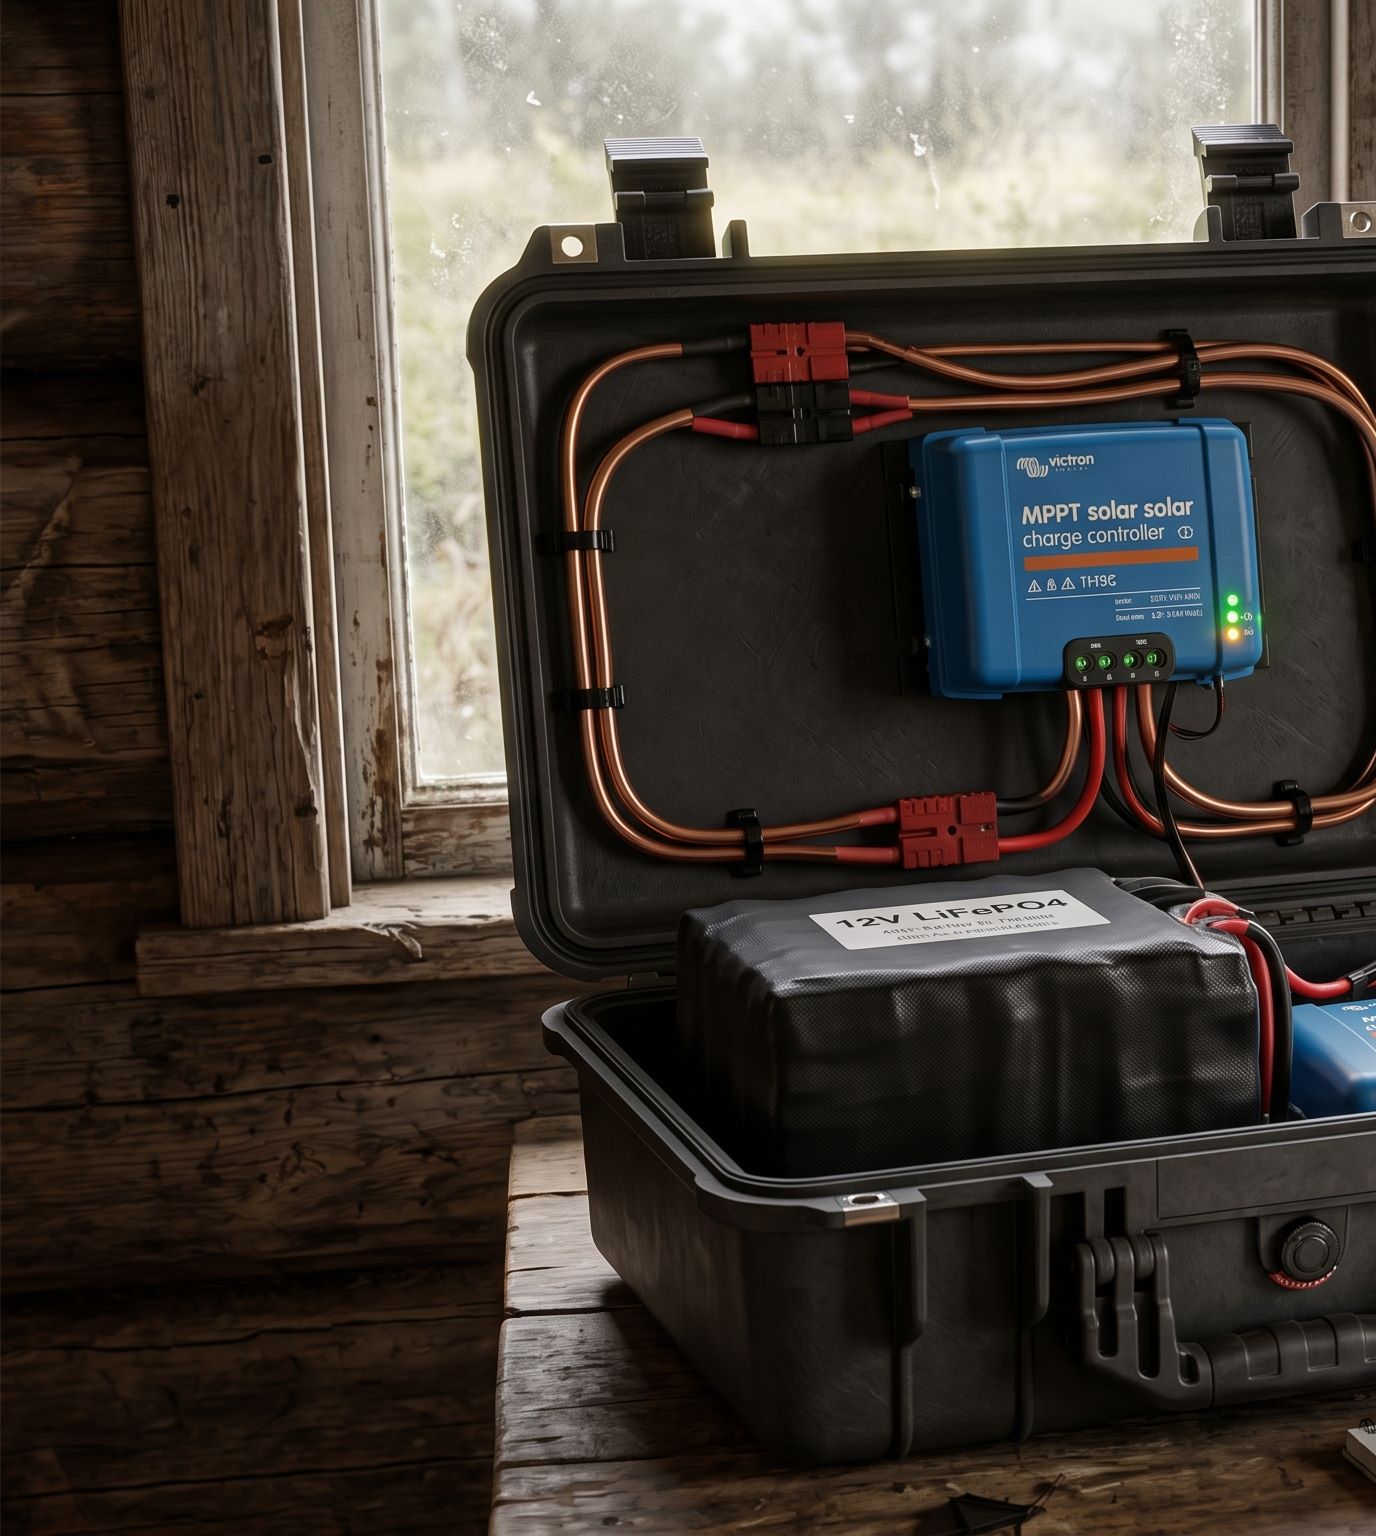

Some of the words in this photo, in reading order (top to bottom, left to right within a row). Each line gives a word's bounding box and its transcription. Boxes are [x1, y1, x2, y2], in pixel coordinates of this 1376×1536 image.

[1049, 454, 1095, 467] victron
[1022, 503, 1081, 525] MPPT
[1087, 499, 1139, 522] solar
[1143, 496, 1194, 518] solar
[1022, 530, 1083, 550] charge
[1087, 523, 1165, 544] controller
[836, 914, 900, 929] 12V
[912, 898, 1068, 922] LiFePO4
